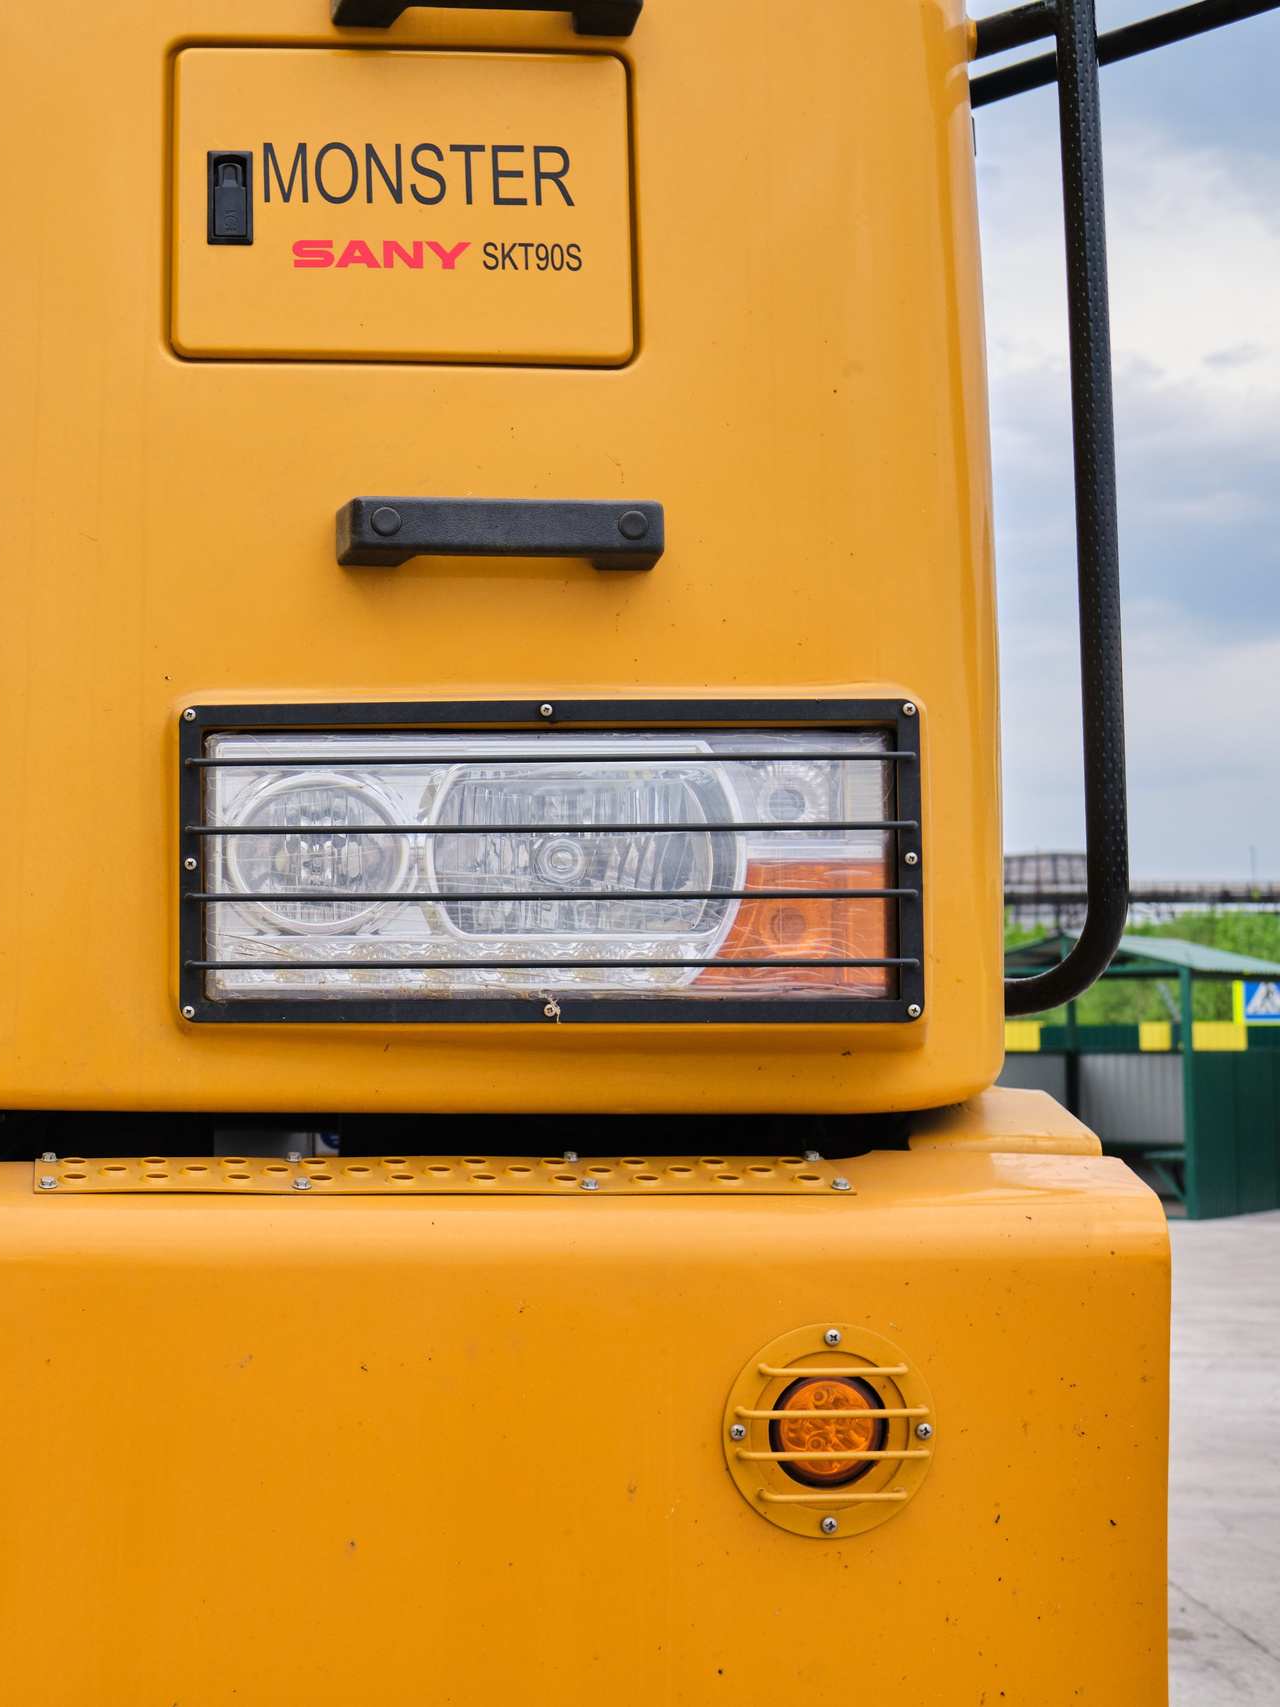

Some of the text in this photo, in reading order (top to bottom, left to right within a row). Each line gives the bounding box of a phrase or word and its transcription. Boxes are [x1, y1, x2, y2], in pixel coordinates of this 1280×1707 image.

[262, 141, 575, 207] MONSTER
[291, 239, 583, 272] SANY SKT90S
